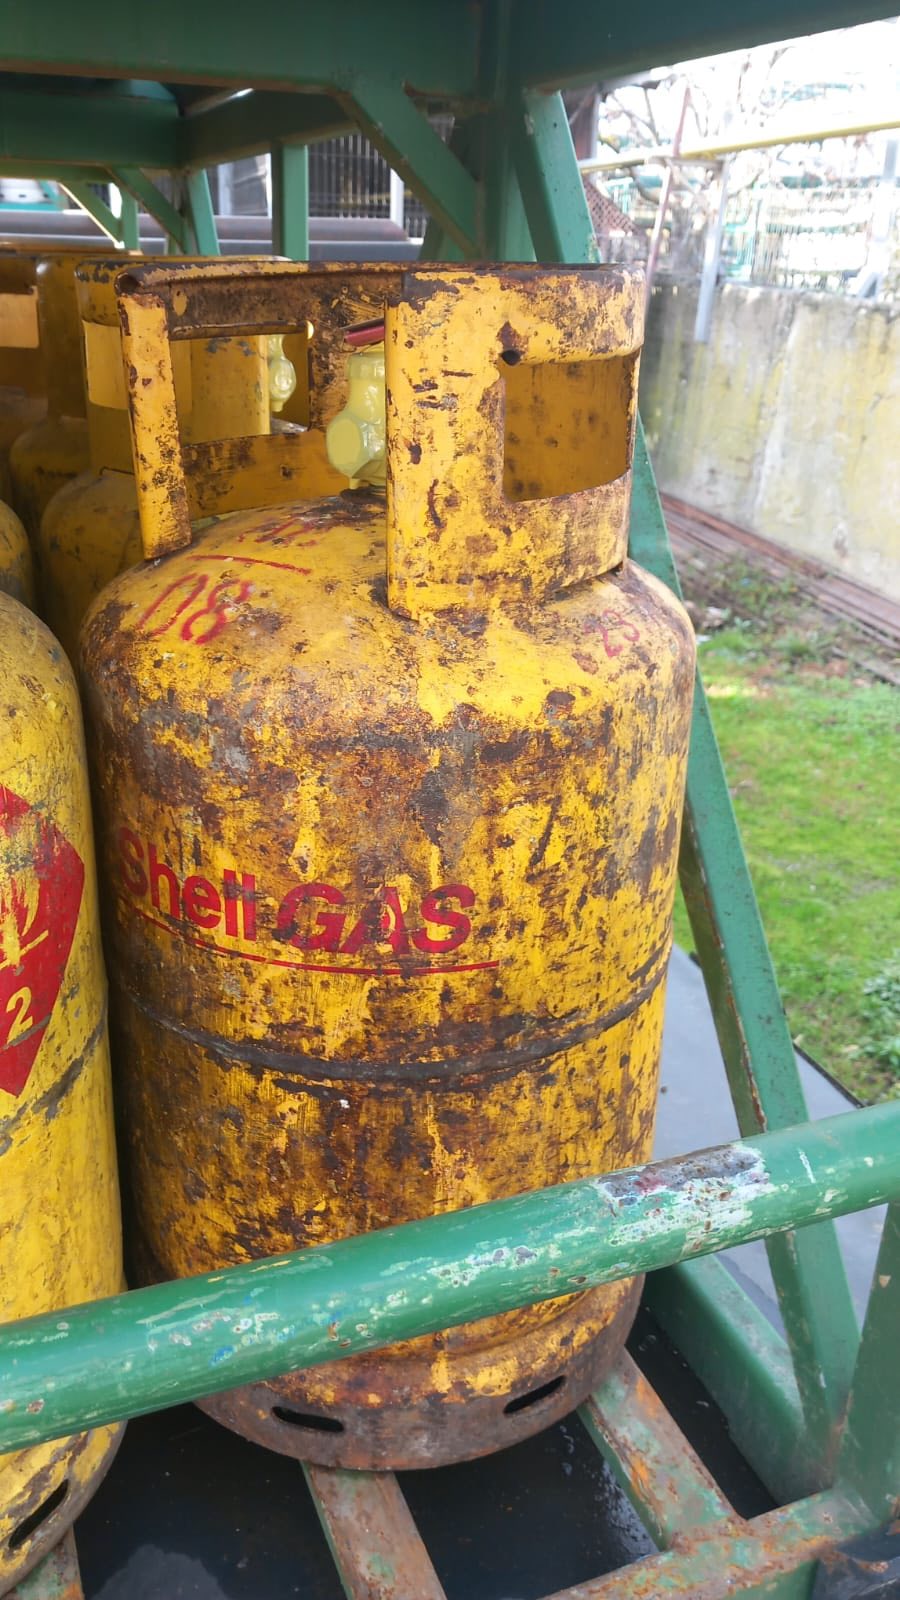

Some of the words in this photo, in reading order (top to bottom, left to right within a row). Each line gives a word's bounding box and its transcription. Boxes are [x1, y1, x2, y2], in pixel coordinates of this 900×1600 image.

[117, 826, 257, 942] Shell
[276, 882, 476, 955] GAS
[6, 986, 34, 1046] 2
